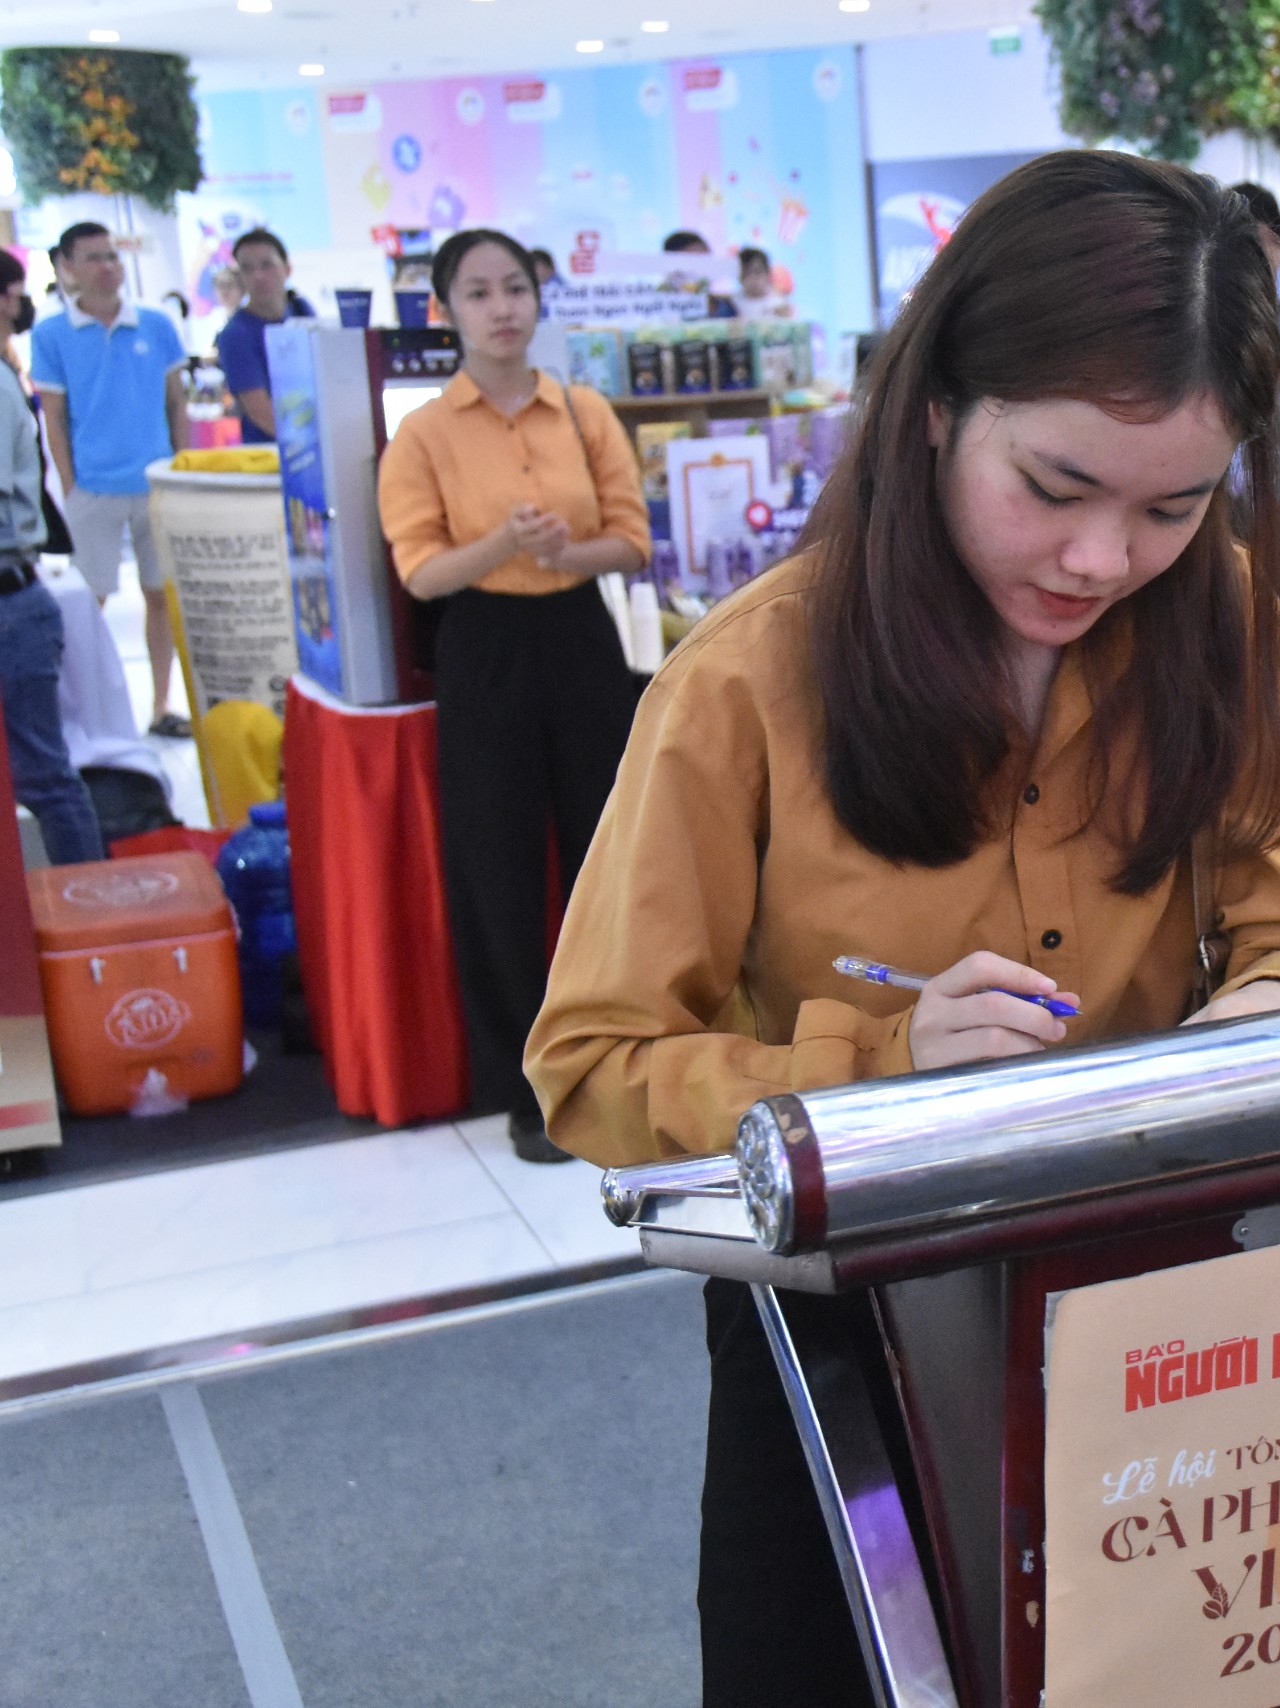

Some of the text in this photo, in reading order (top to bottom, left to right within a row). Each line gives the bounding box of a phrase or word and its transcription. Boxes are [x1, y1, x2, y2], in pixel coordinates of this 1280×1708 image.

[1124, 1336, 1259, 1413] NGƯỜI
[1125, 1339, 1185, 1365] BÁO
[1102, 1457, 1157, 1505] Lễ
[1167, 1449, 1217, 1488] hội
[1101, 1496, 1188, 1562] CÀ
